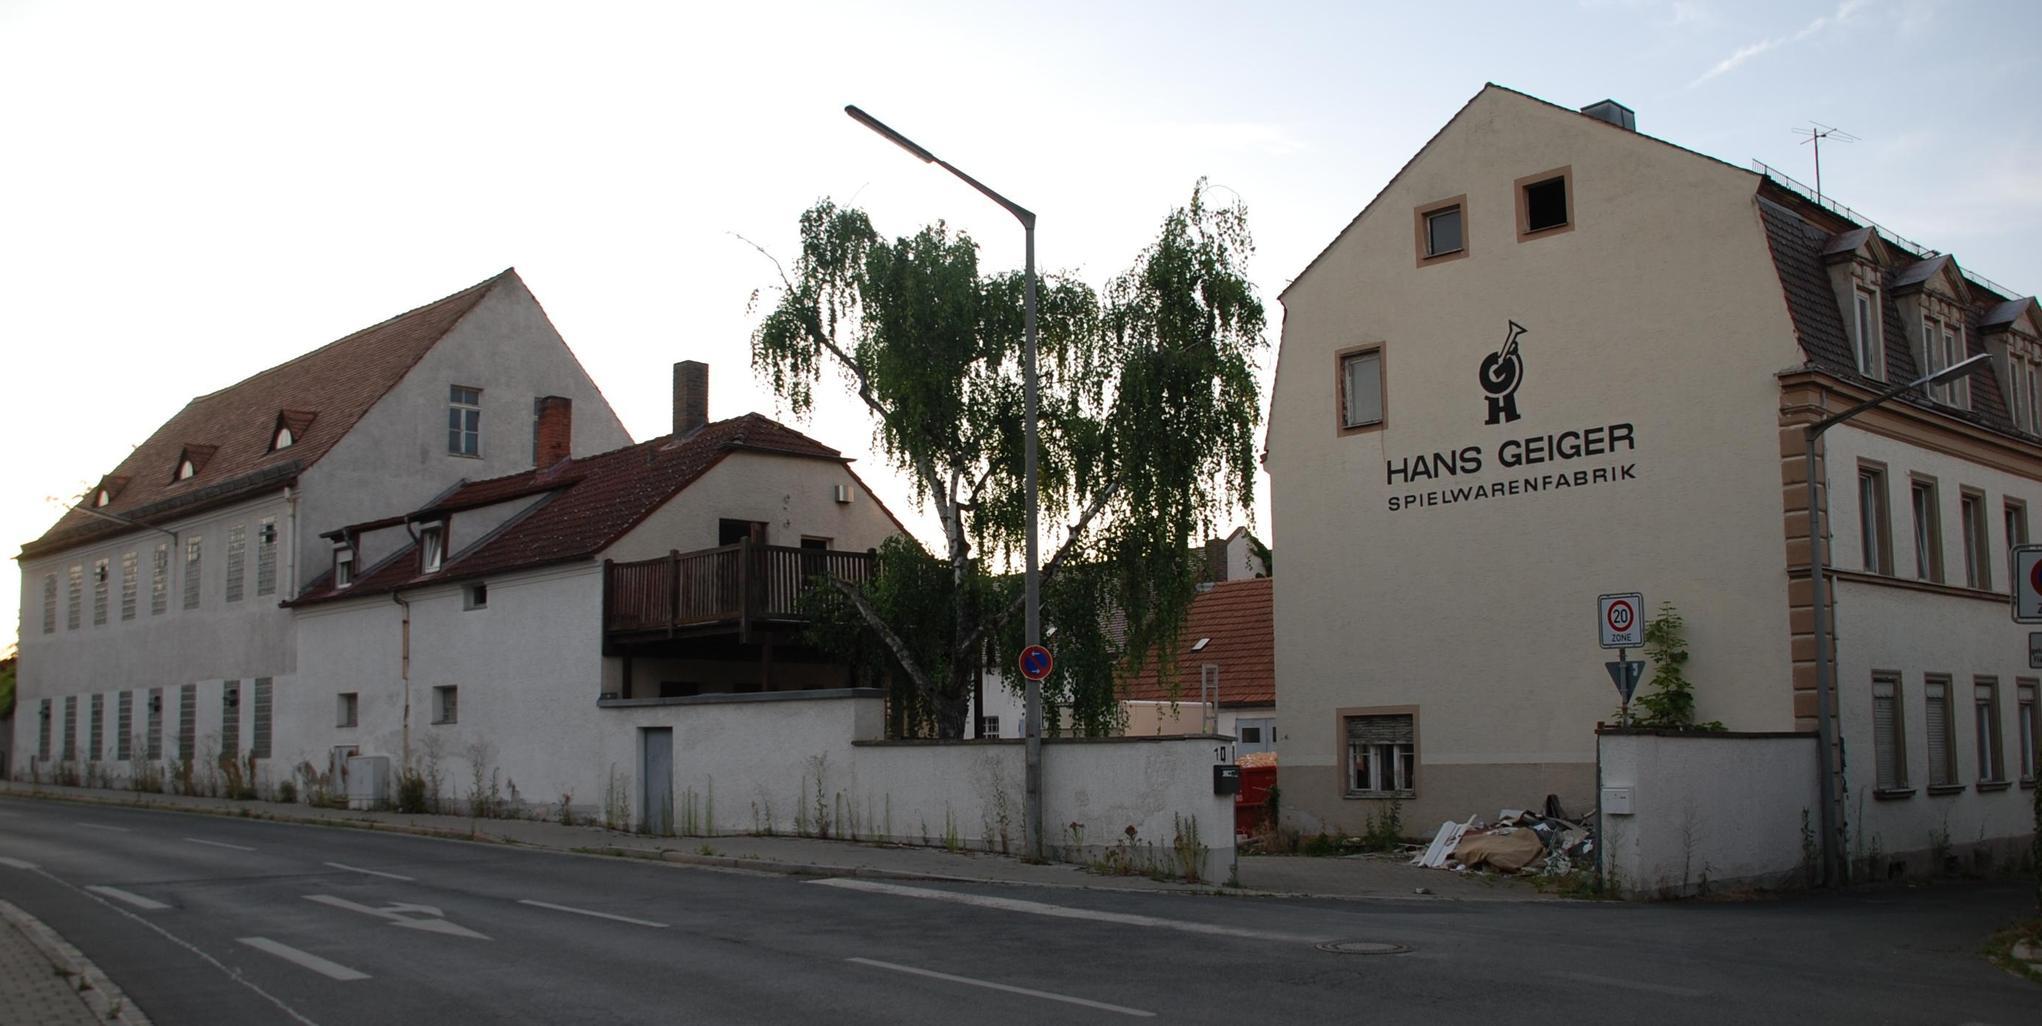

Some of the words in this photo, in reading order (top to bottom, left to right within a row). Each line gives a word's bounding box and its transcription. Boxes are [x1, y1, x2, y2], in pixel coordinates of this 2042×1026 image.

[1386, 446, 1482, 485] HANS
[1498, 422, 1635, 468] GEIGER
[1388, 463, 1636, 511] SPIELWARENFABRIK
[1613, 609, 1628, 624] 20
[1611, 633, 1632, 642] ZONE
[1214, 746, 1226, 761] 10
